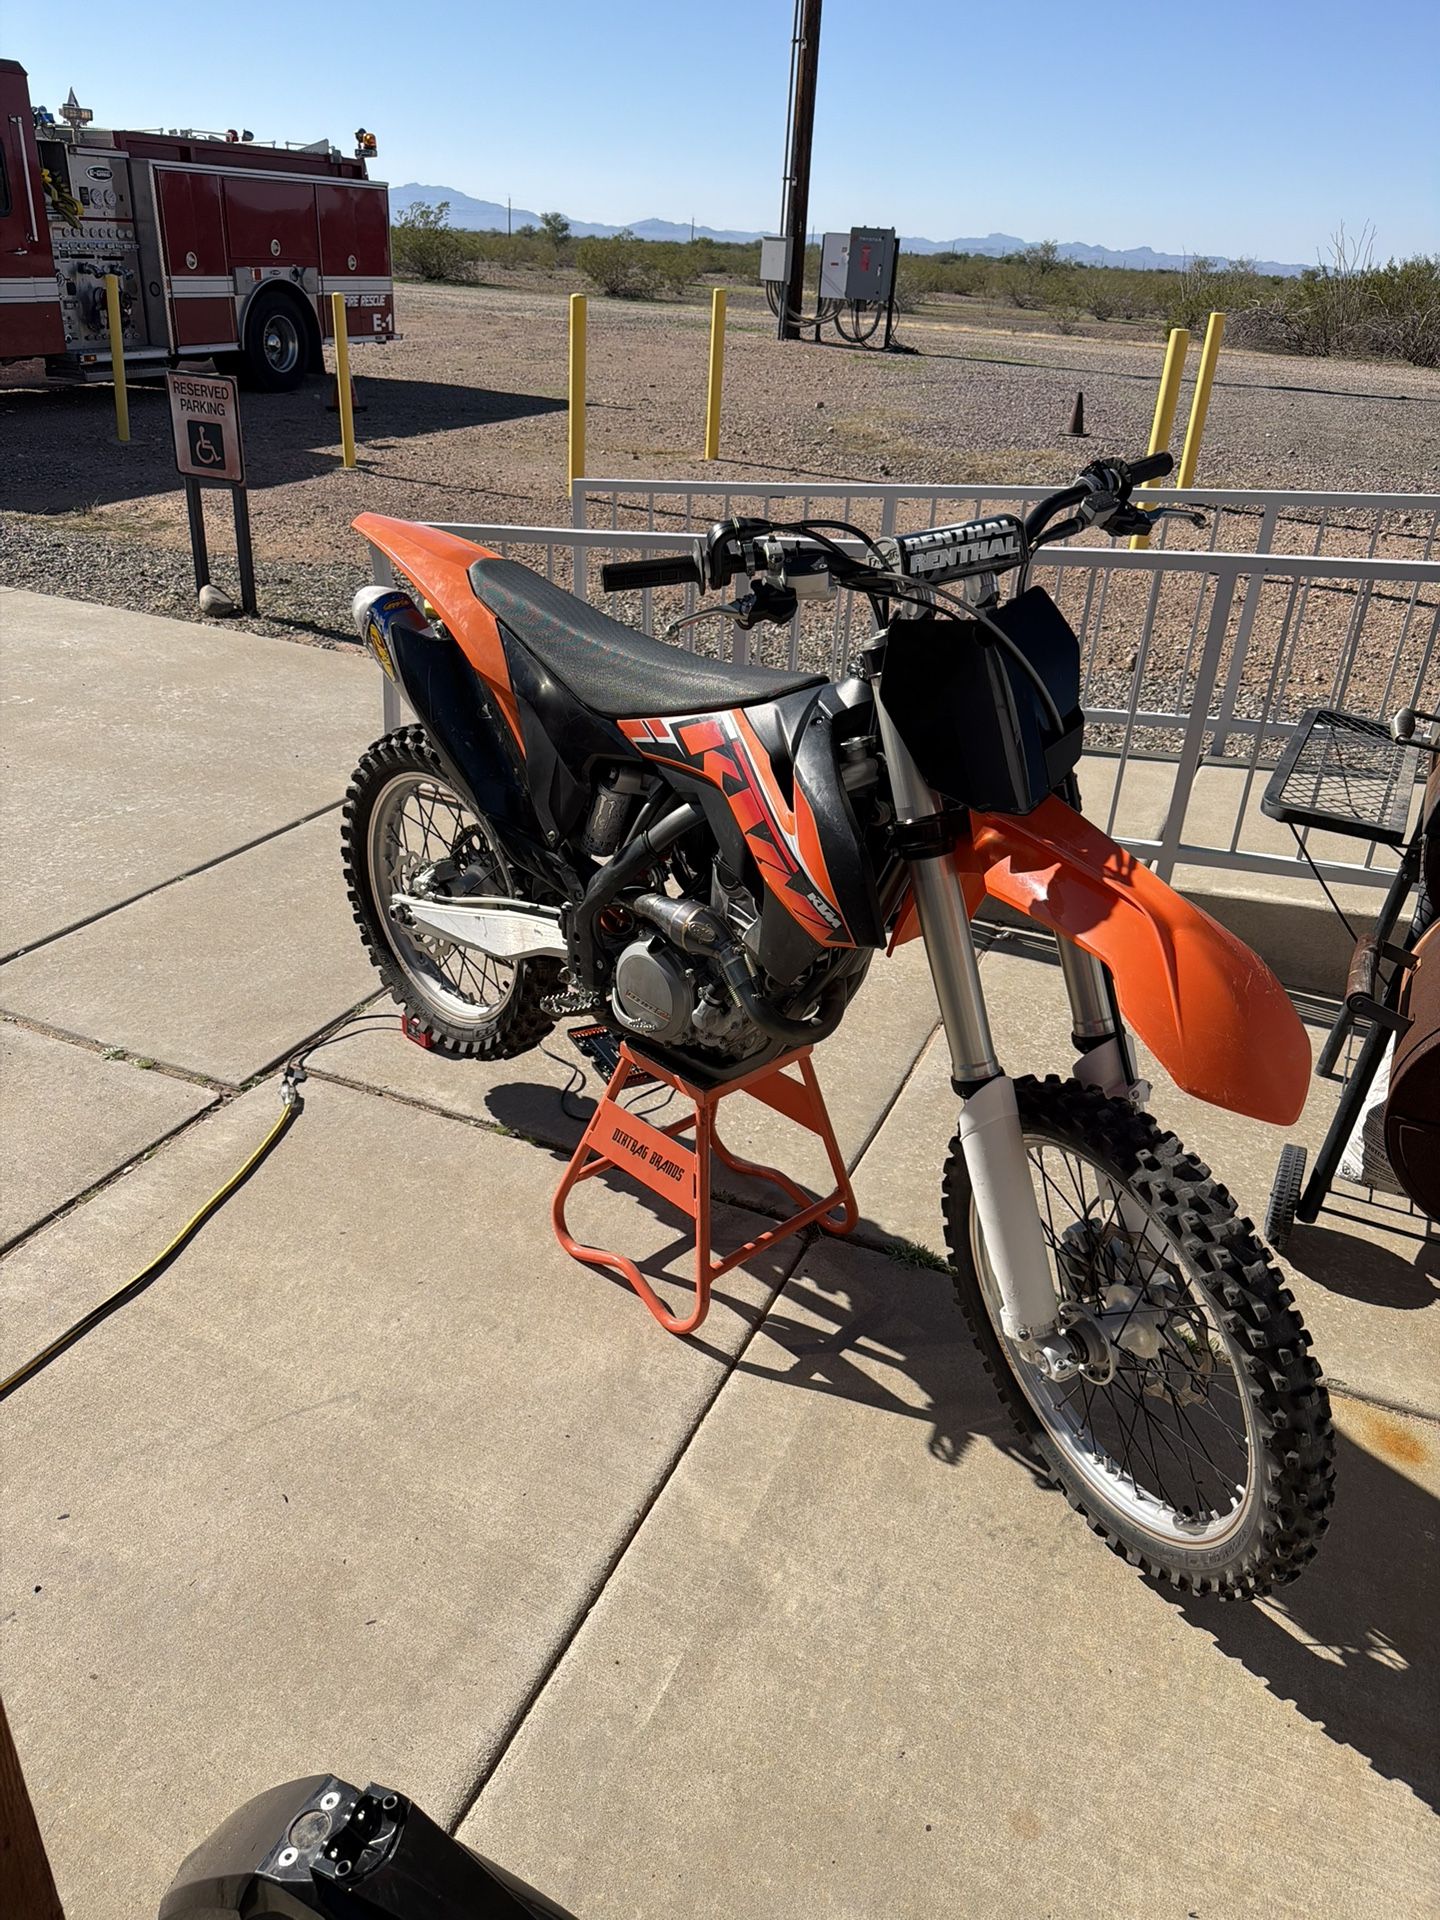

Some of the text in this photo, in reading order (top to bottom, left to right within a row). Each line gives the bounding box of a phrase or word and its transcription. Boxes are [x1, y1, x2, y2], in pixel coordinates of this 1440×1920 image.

[360, 294, 386, 307] RESCUE
[373, 313, 393, 332] E-1
[173, 381, 229, 400] RESERVED
[180, 399, 225, 416] PARKING
[904, 519, 1017, 550] RENTHAL
[909, 535, 1020, 574] RENTHAL
[806, 892, 842, 929] KTM
[611, 1127, 686, 1182] DIRTBAG BRANDS
